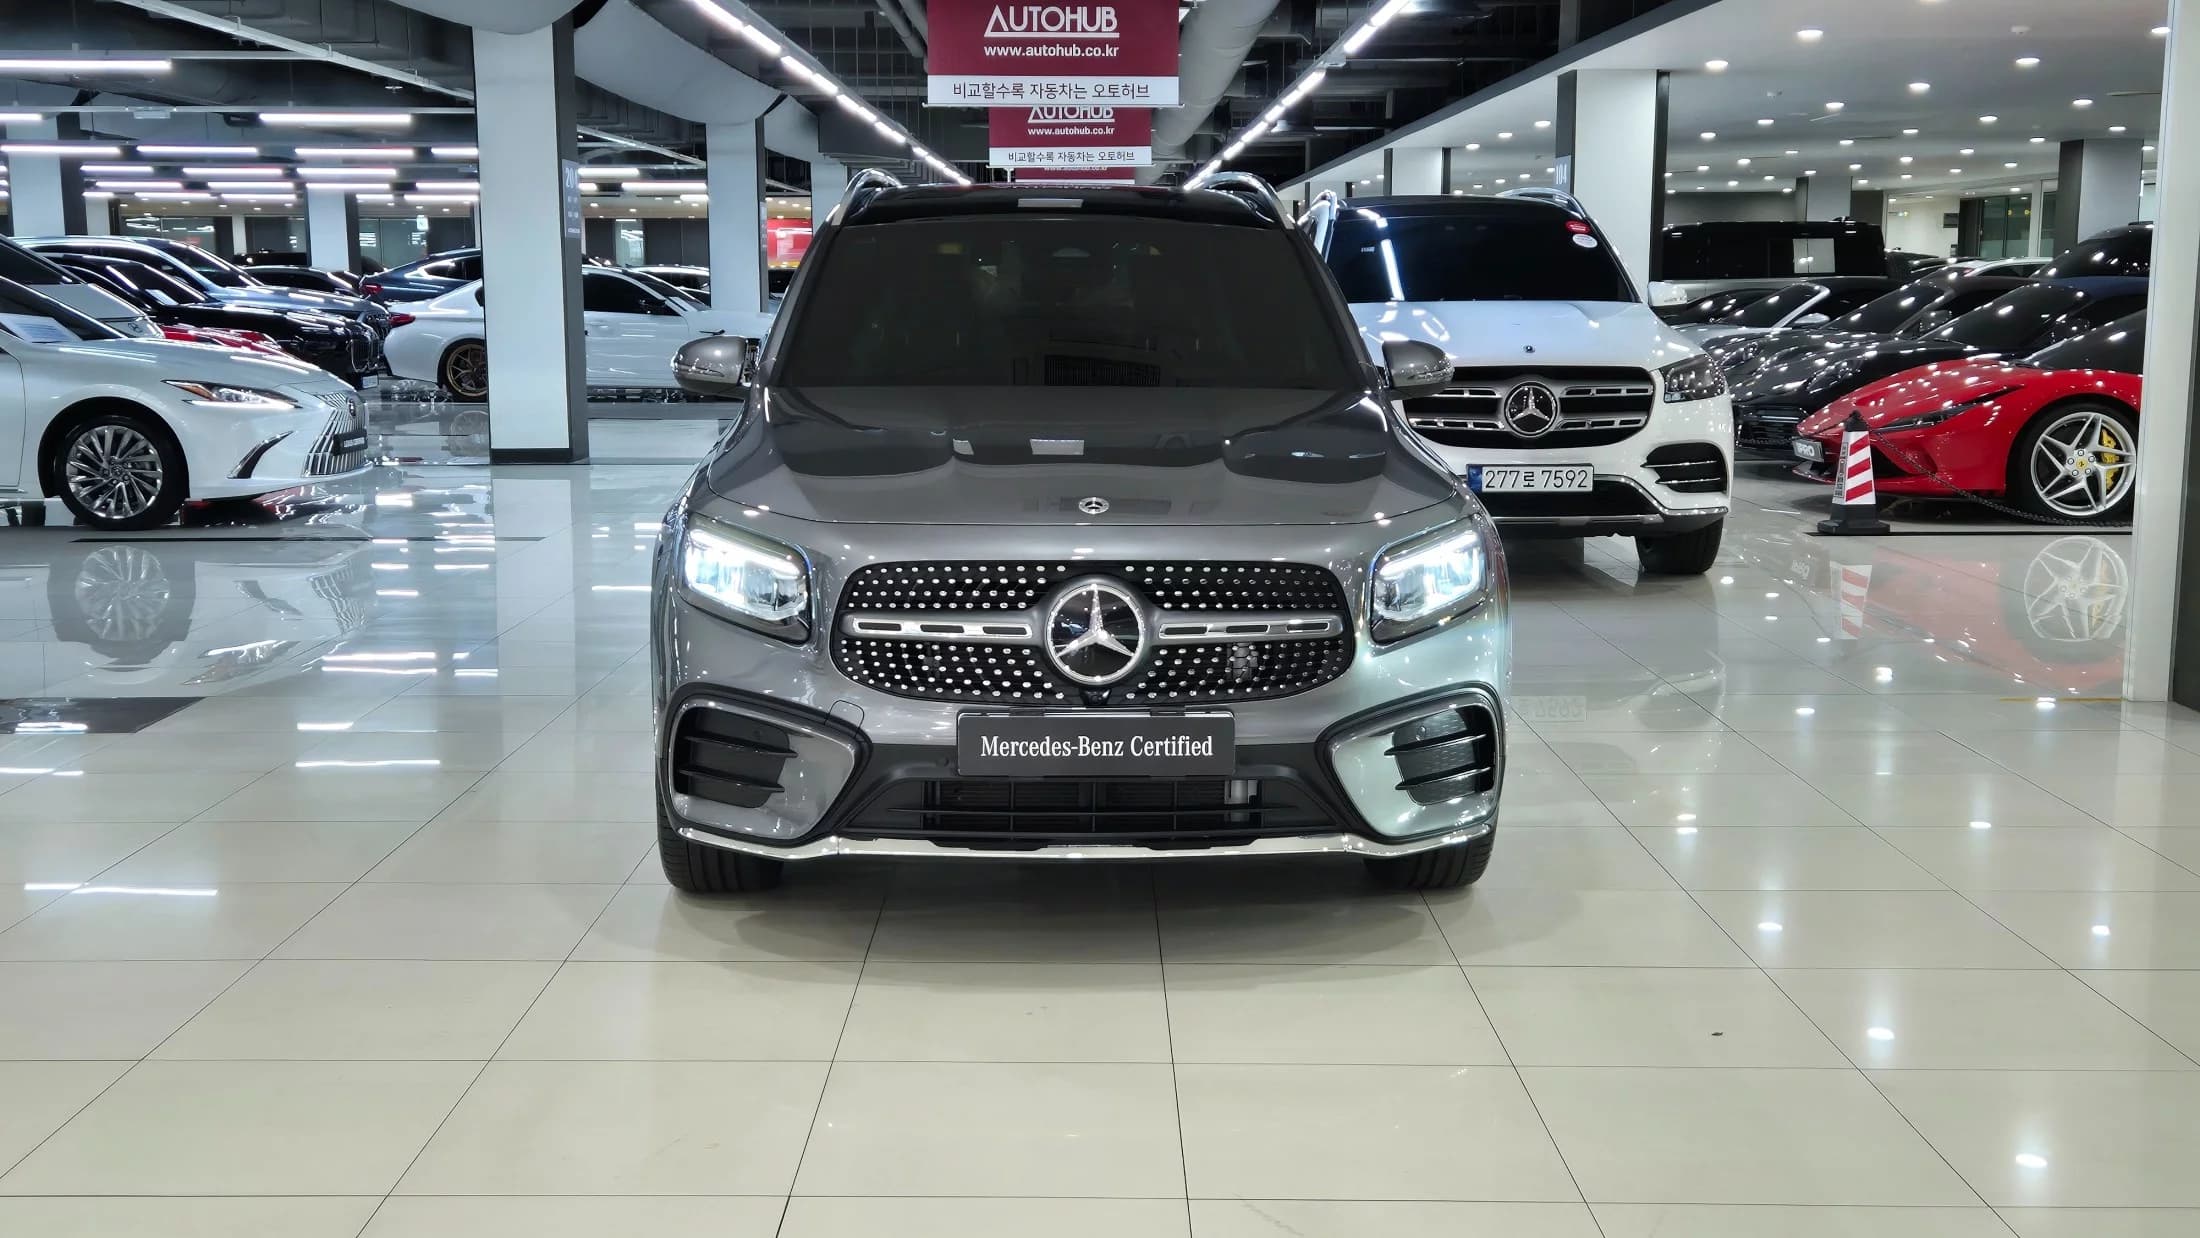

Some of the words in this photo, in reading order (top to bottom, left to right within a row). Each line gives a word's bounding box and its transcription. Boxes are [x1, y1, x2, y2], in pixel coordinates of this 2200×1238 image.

[984, 5, 1120, 38] AUTOHUB
[984, 44, 1119, 57] www.autohub.co.kr
[953, 83, 1025, 100] 비교할수록
[1029, 83, 1088, 100] 자동차는
[1092, 84, 1150, 99] 오토허브
[1027, 107, 1115, 123] AUTOHUB
[1027, 126, 1115, 136] www.autohub.co.kr
[1008, 152, 1054, 162] 비교할수록
[1058, 152, 1095, 162] 자동차는
[1098, 152, 1135, 161] 오토허브
[1485, 470, 1535, 489] 277로
[1541, 469, 1588, 488] 7592
[980, 735, 1124, 757] Mercedes-Benz
[1130, 735, 1213, 756] Certified
